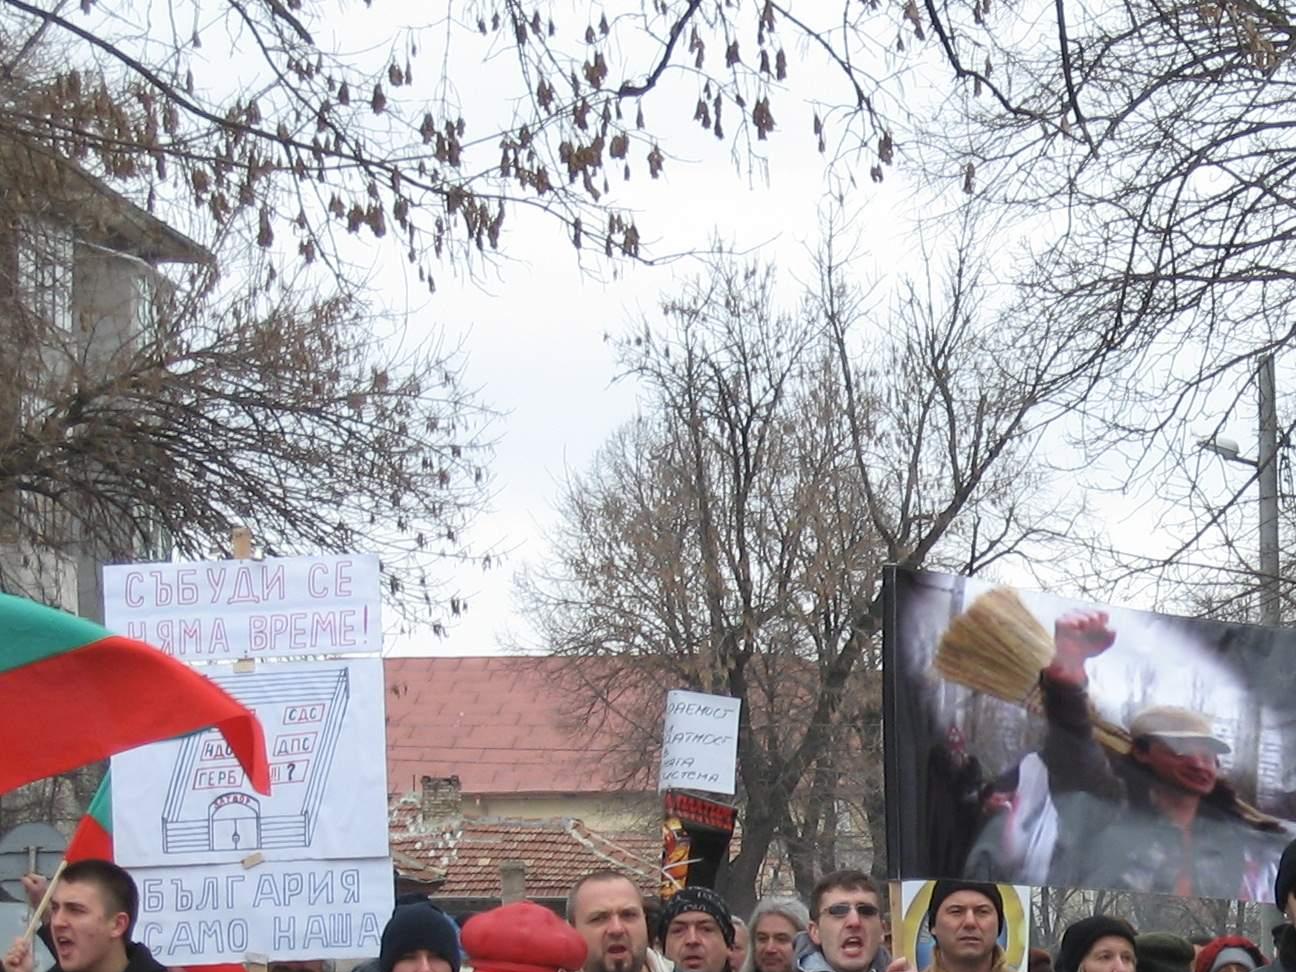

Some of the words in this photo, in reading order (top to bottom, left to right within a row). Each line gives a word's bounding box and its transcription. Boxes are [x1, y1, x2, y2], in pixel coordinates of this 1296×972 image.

[125, 565, 286, 608] СЪБУДИ
[308, 561, 352, 598] СЕ
[250, 604, 368, 651] ВРЕМЕ!
[289, 706, 317, 721] СДС
[277, 737, 310, 754] ДПС
[199, 769, 237, 785] ГЕРБ
[143, 868, 360, 912] БЪЛГАРИЯ
[144, 917, 248, 956] САМО
[273, 912, 381, 951] НАША
